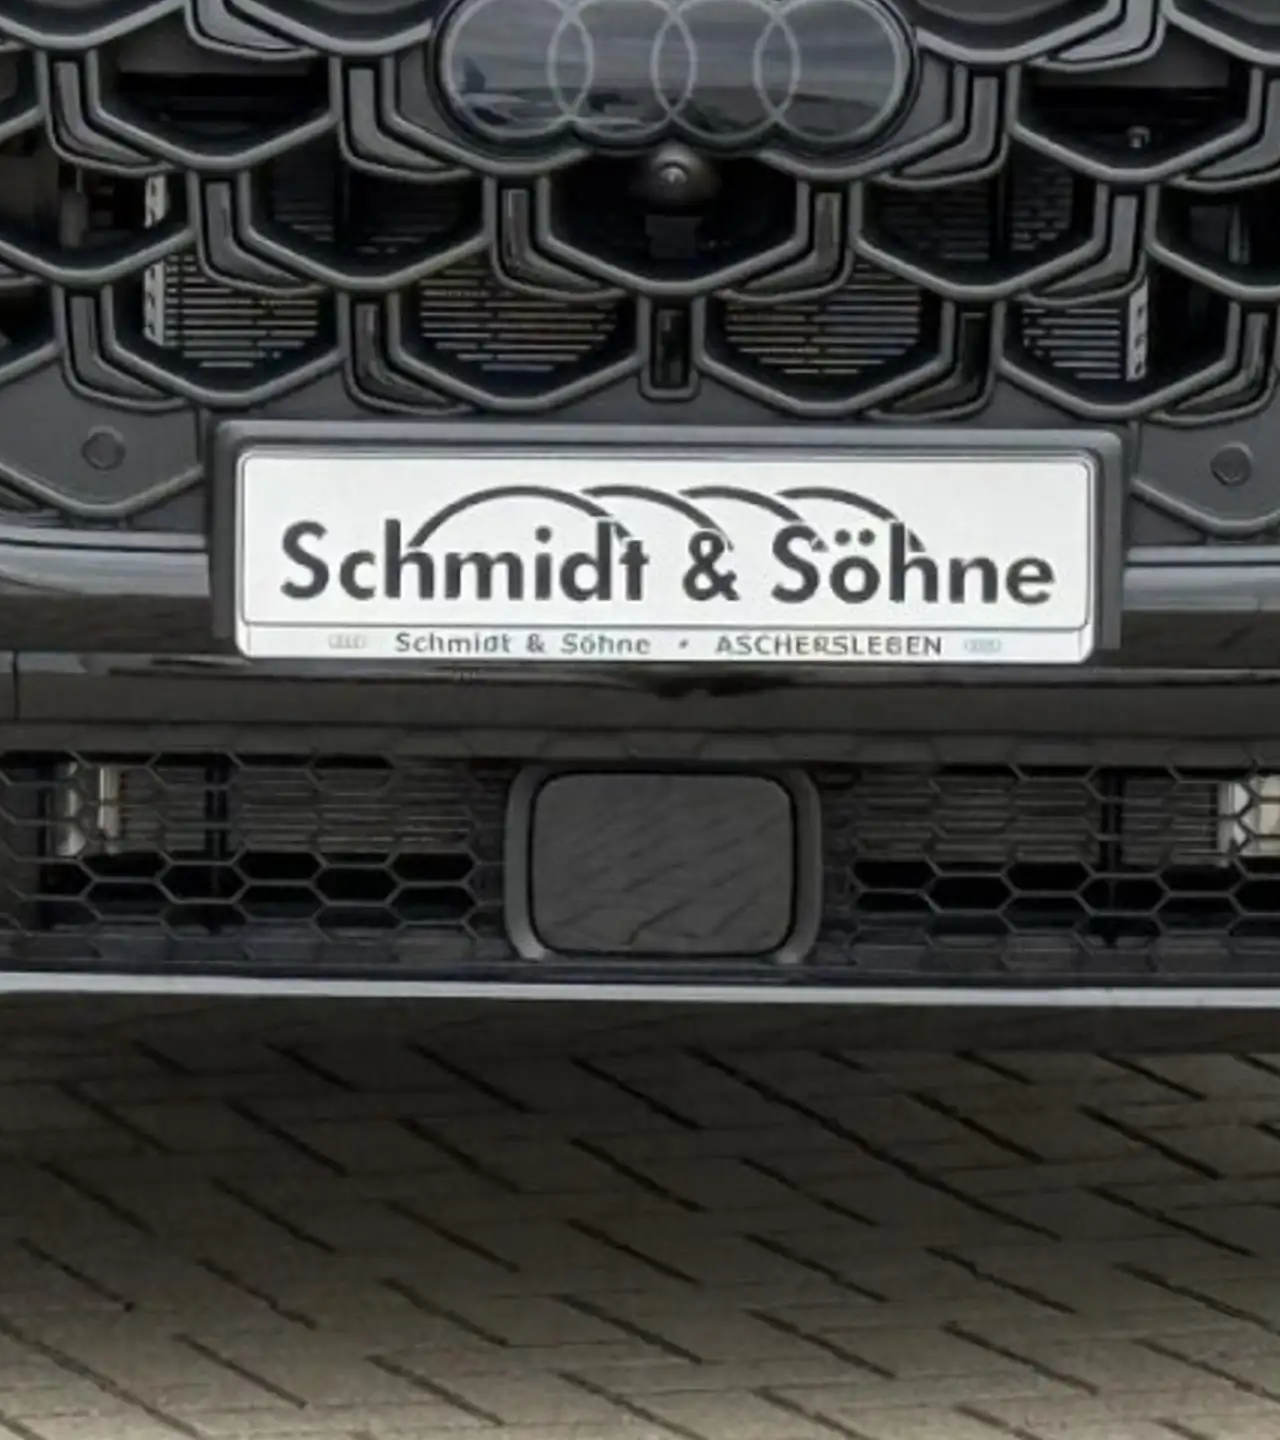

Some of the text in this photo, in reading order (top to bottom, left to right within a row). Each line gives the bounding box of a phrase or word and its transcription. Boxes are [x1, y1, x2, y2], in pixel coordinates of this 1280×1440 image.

[281, 518, 1056, 605] Schmidt & Söhne
[395, 632, 943, 656] Schmidt & Söhne ASCHERSLEBEN
